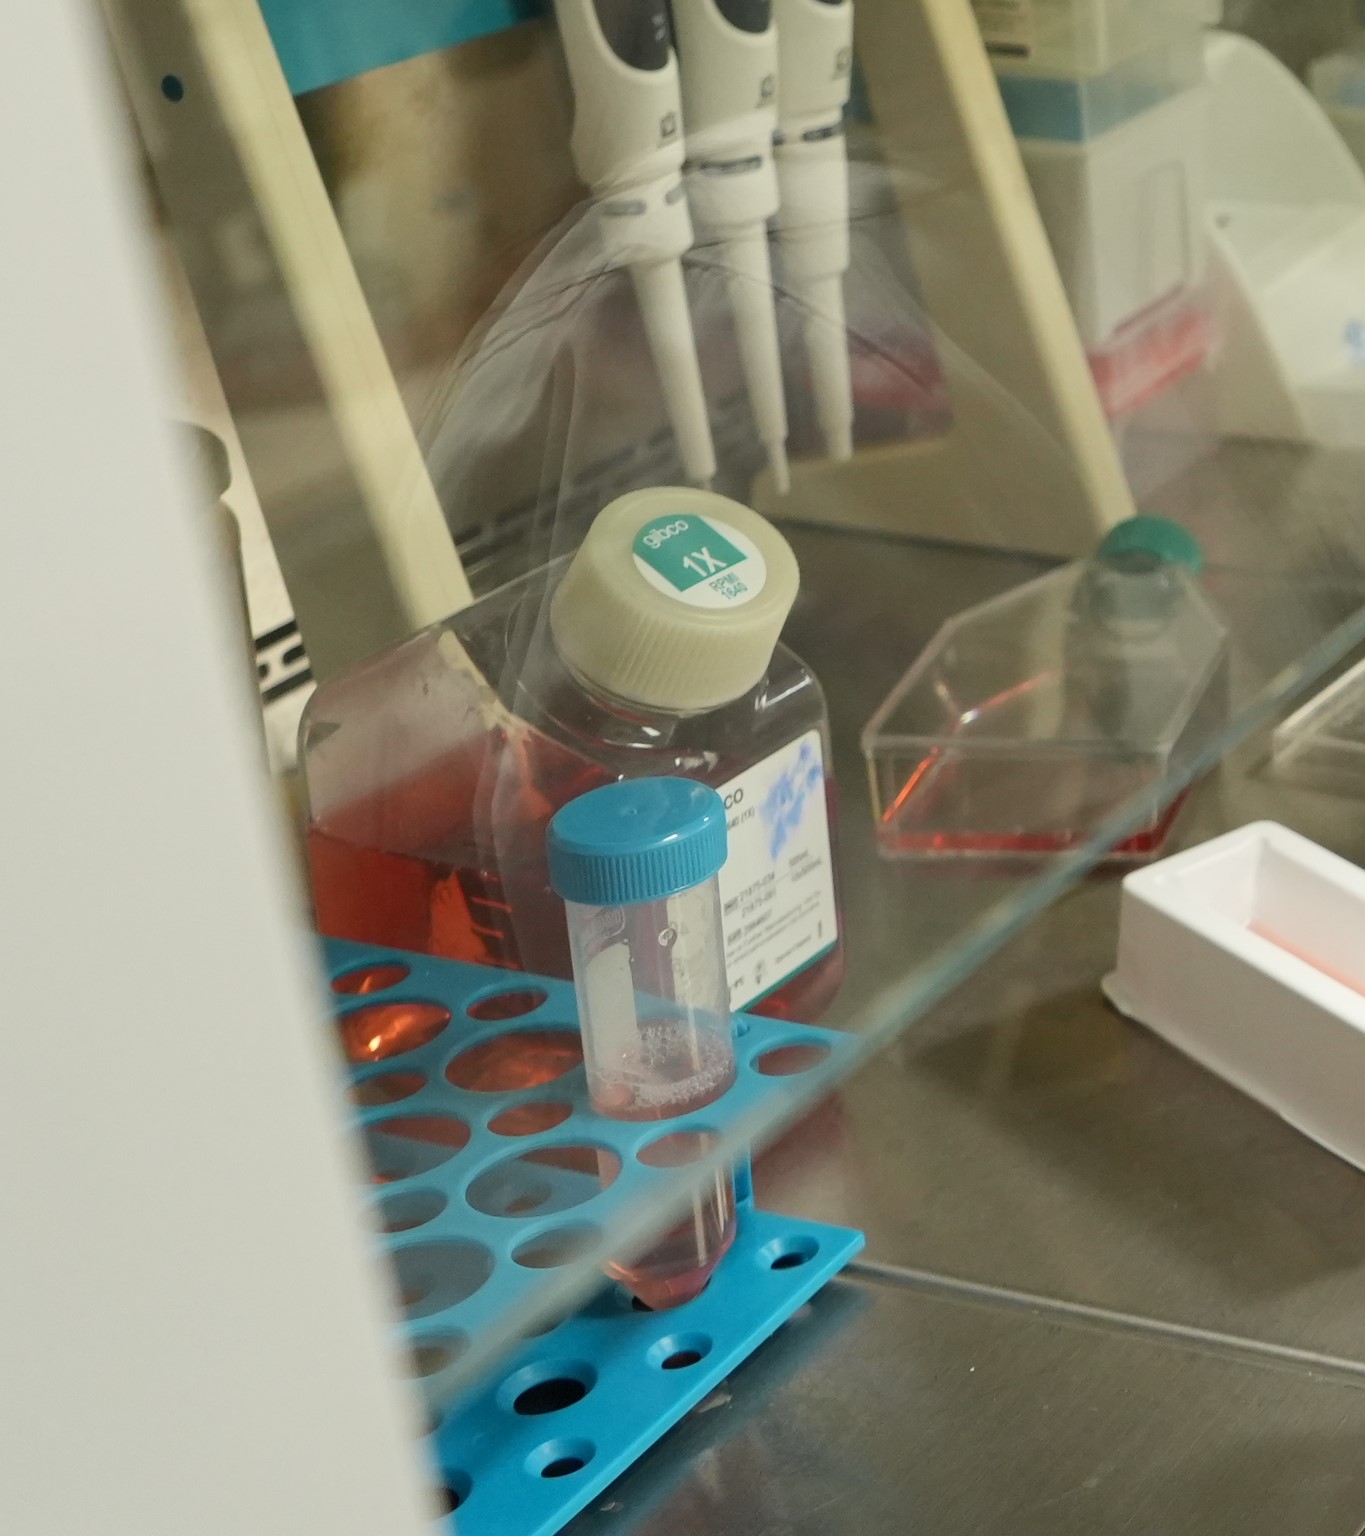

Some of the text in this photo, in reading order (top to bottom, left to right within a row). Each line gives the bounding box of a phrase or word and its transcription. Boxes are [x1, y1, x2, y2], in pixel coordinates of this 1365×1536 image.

[643, 520, 689, 549] gibco
[683, 547, 727, 577] 1X
[708, 572, 740, 592] RPMI
[721, 582, 748, 600] 1640
